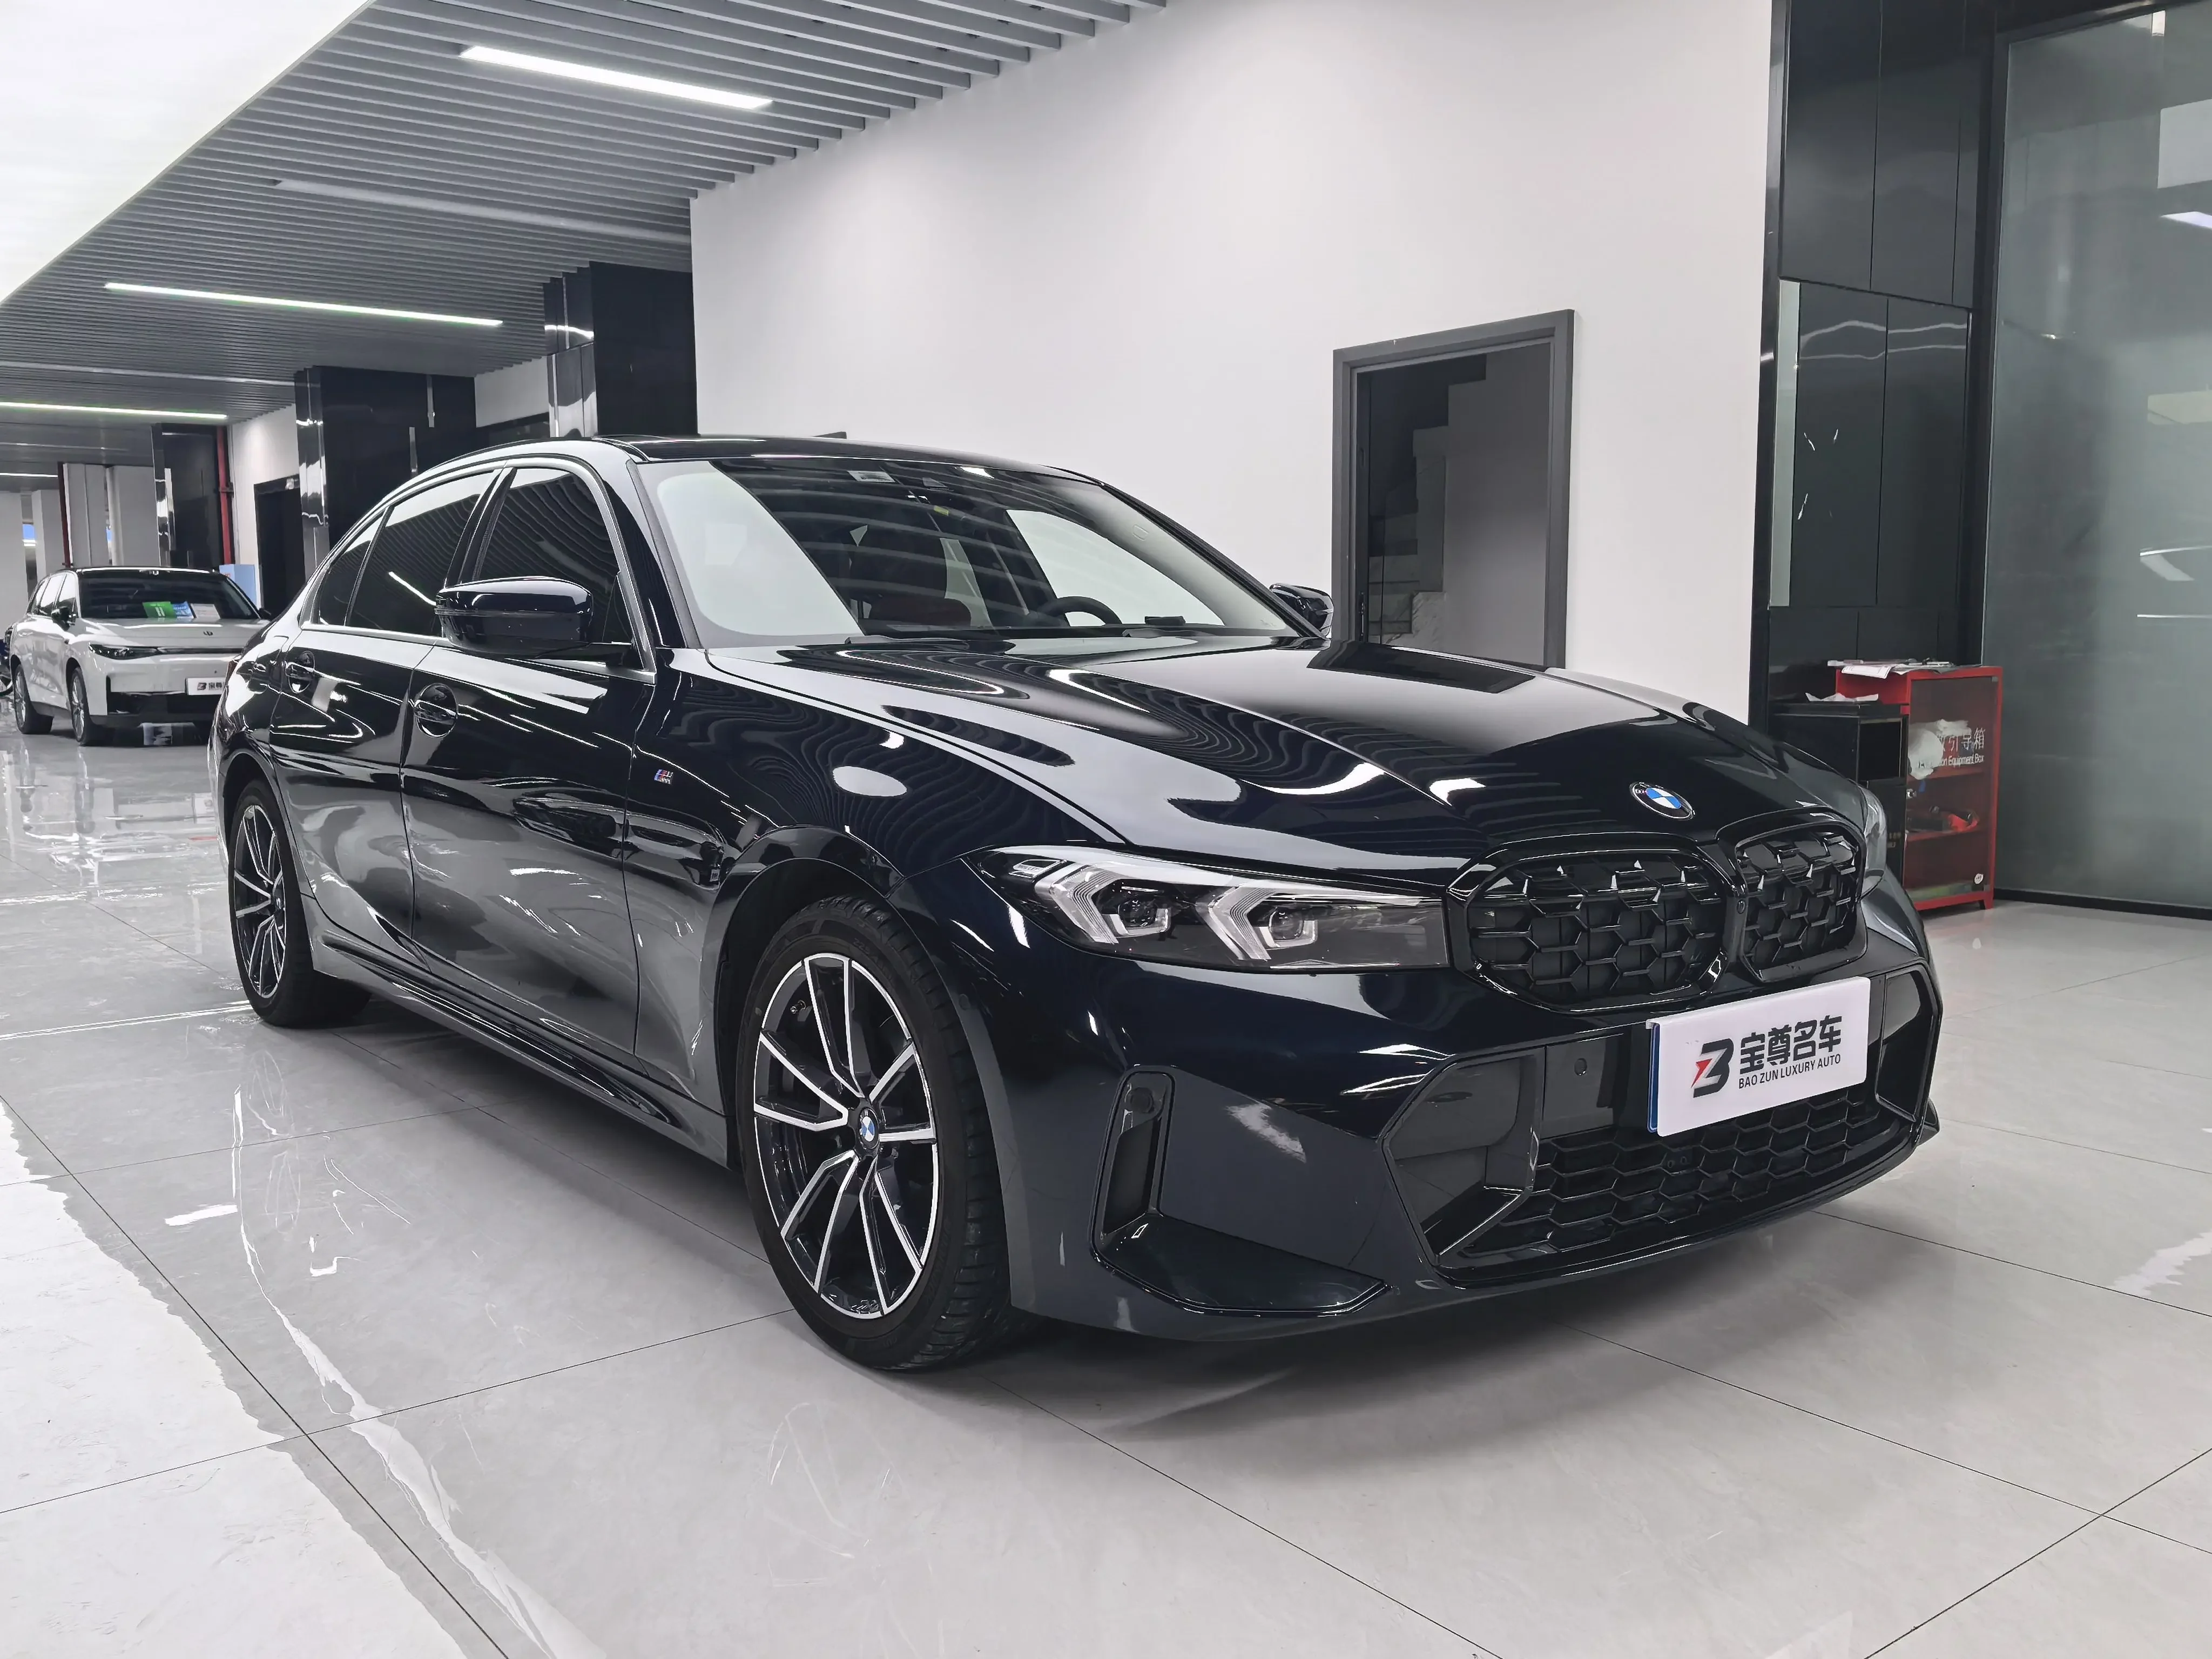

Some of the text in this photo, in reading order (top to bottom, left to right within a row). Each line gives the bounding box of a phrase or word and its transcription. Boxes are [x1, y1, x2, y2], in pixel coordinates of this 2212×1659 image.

[1739, 1015, 1842, 1075] 宝尊名车
[1739, 1054, 1841, 1089] BAO ZUN LUXURY AUTO
